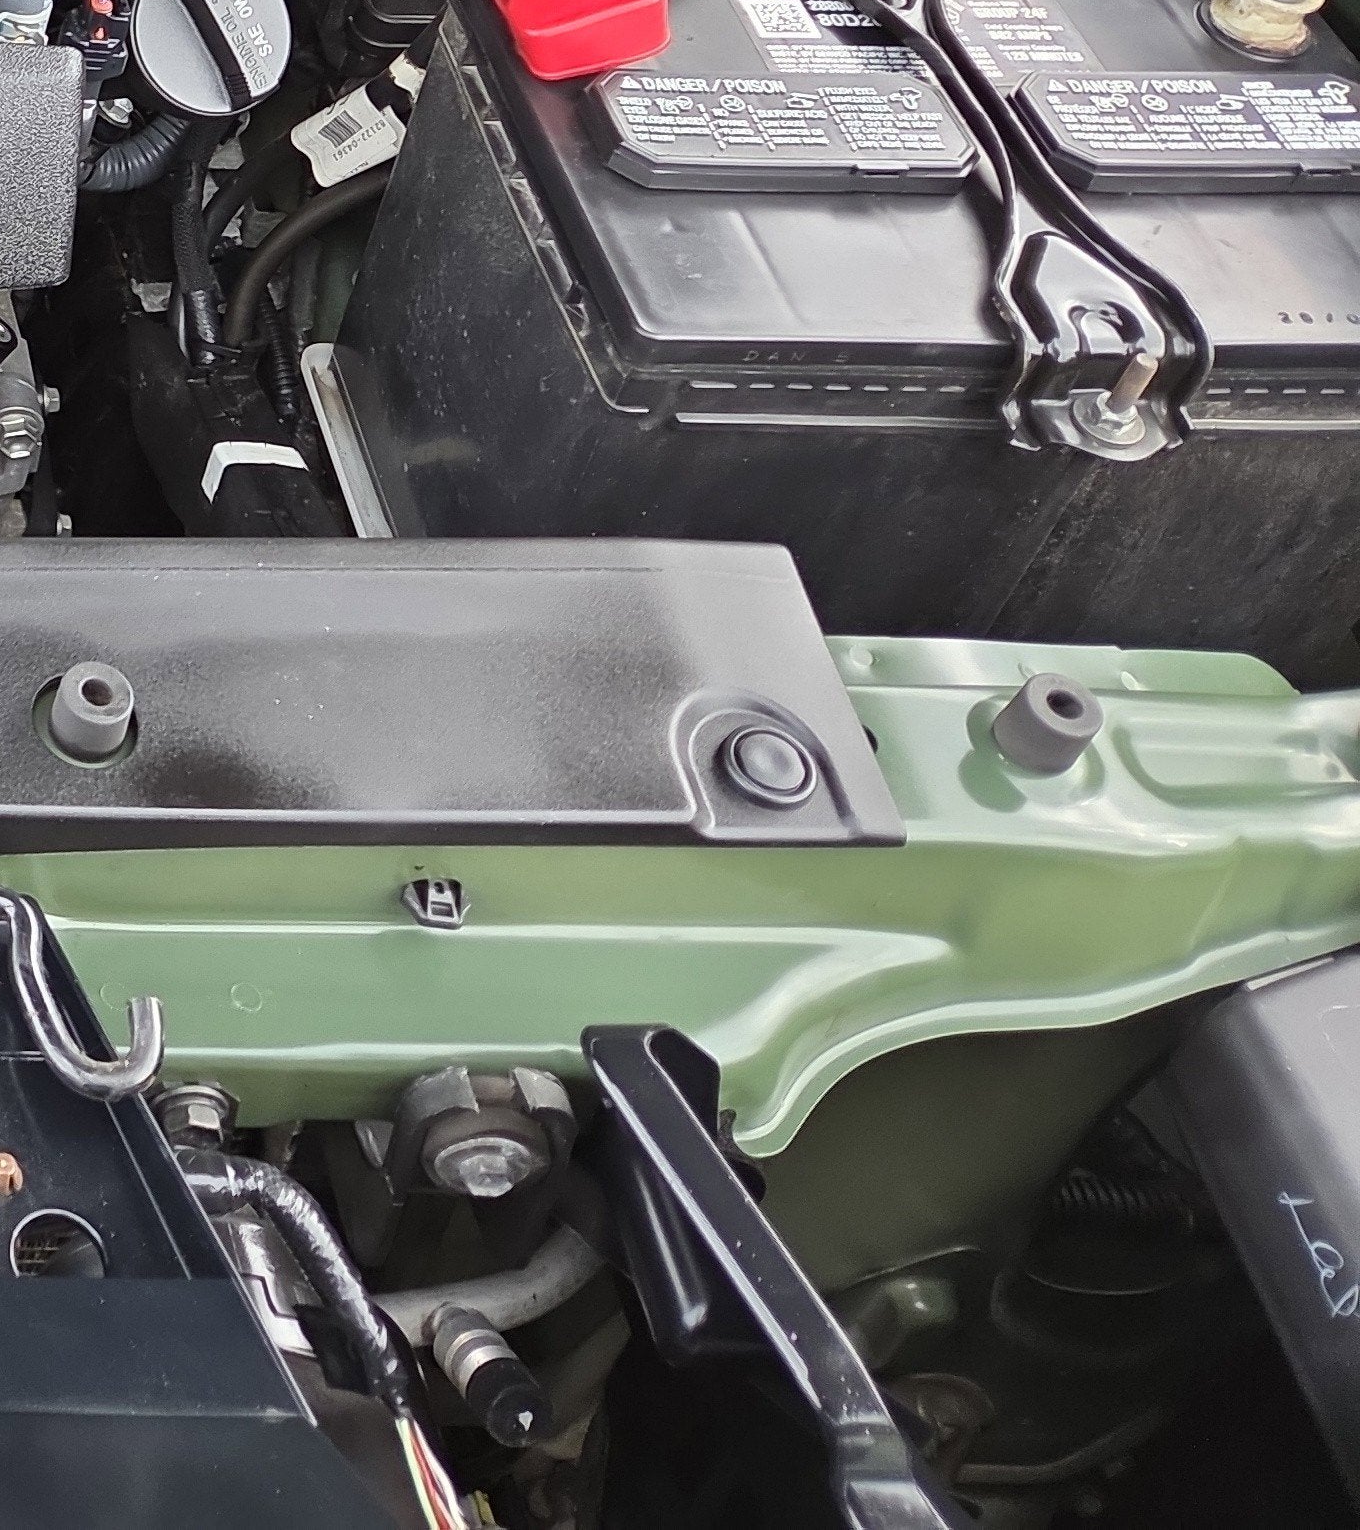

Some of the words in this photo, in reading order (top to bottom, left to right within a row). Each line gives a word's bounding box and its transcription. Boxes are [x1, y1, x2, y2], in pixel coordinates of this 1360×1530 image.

[815, 13, 882, 27] 80D2
[247, 22, 274, 58] SAE
[641, 77, 710, 92] DANGER
[723, 79, 787, 94] POISON
[1066, 79, 1139, 94] DANGER
[1150, 79, 1218, 94] POISON
